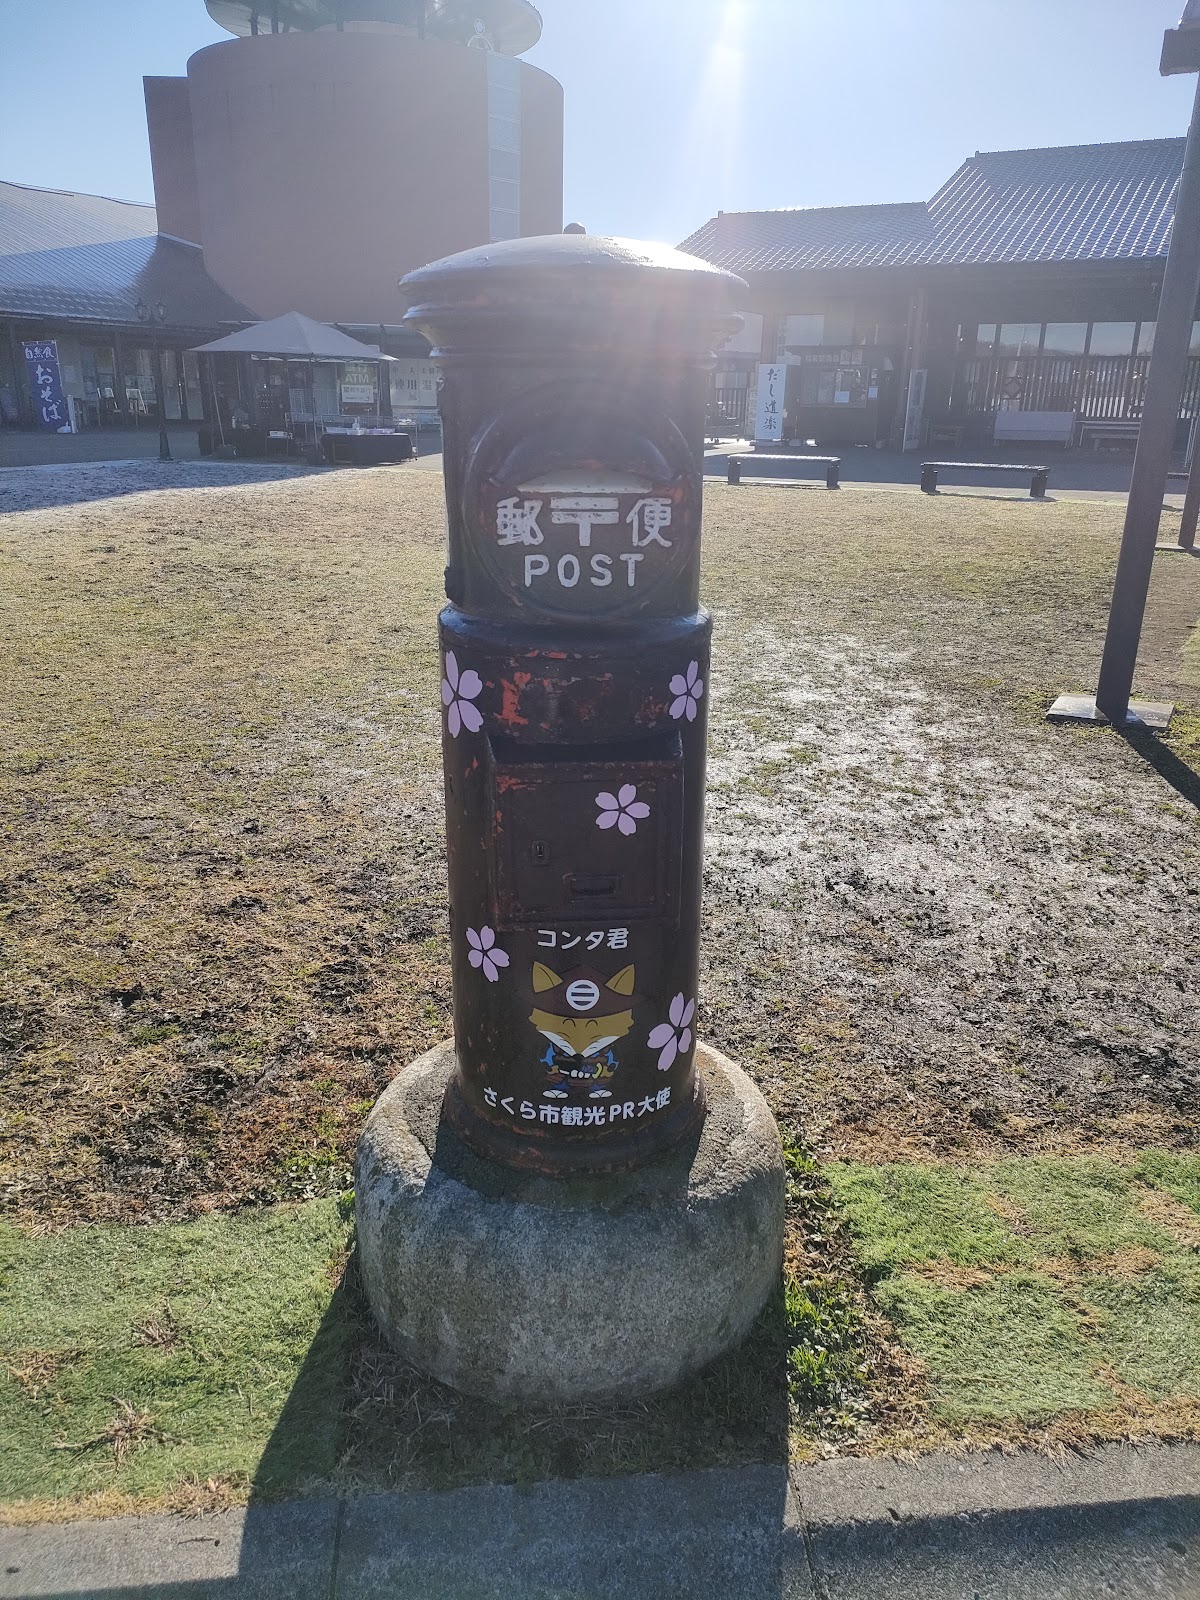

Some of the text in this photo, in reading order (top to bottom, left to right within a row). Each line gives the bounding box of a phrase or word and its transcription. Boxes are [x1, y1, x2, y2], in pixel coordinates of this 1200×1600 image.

[25, 346, 54, 359] 自然食
[35, 364, 62, 422] おそば
[345, 373, 369, 383] ATM
[763, 368, 781, 430] だし道楽
[524, 553, 645, 588] POST
[537, 927, 629, 950] コンタ君
[482, 1086, 672, 1127] さくら市観光PR大使
